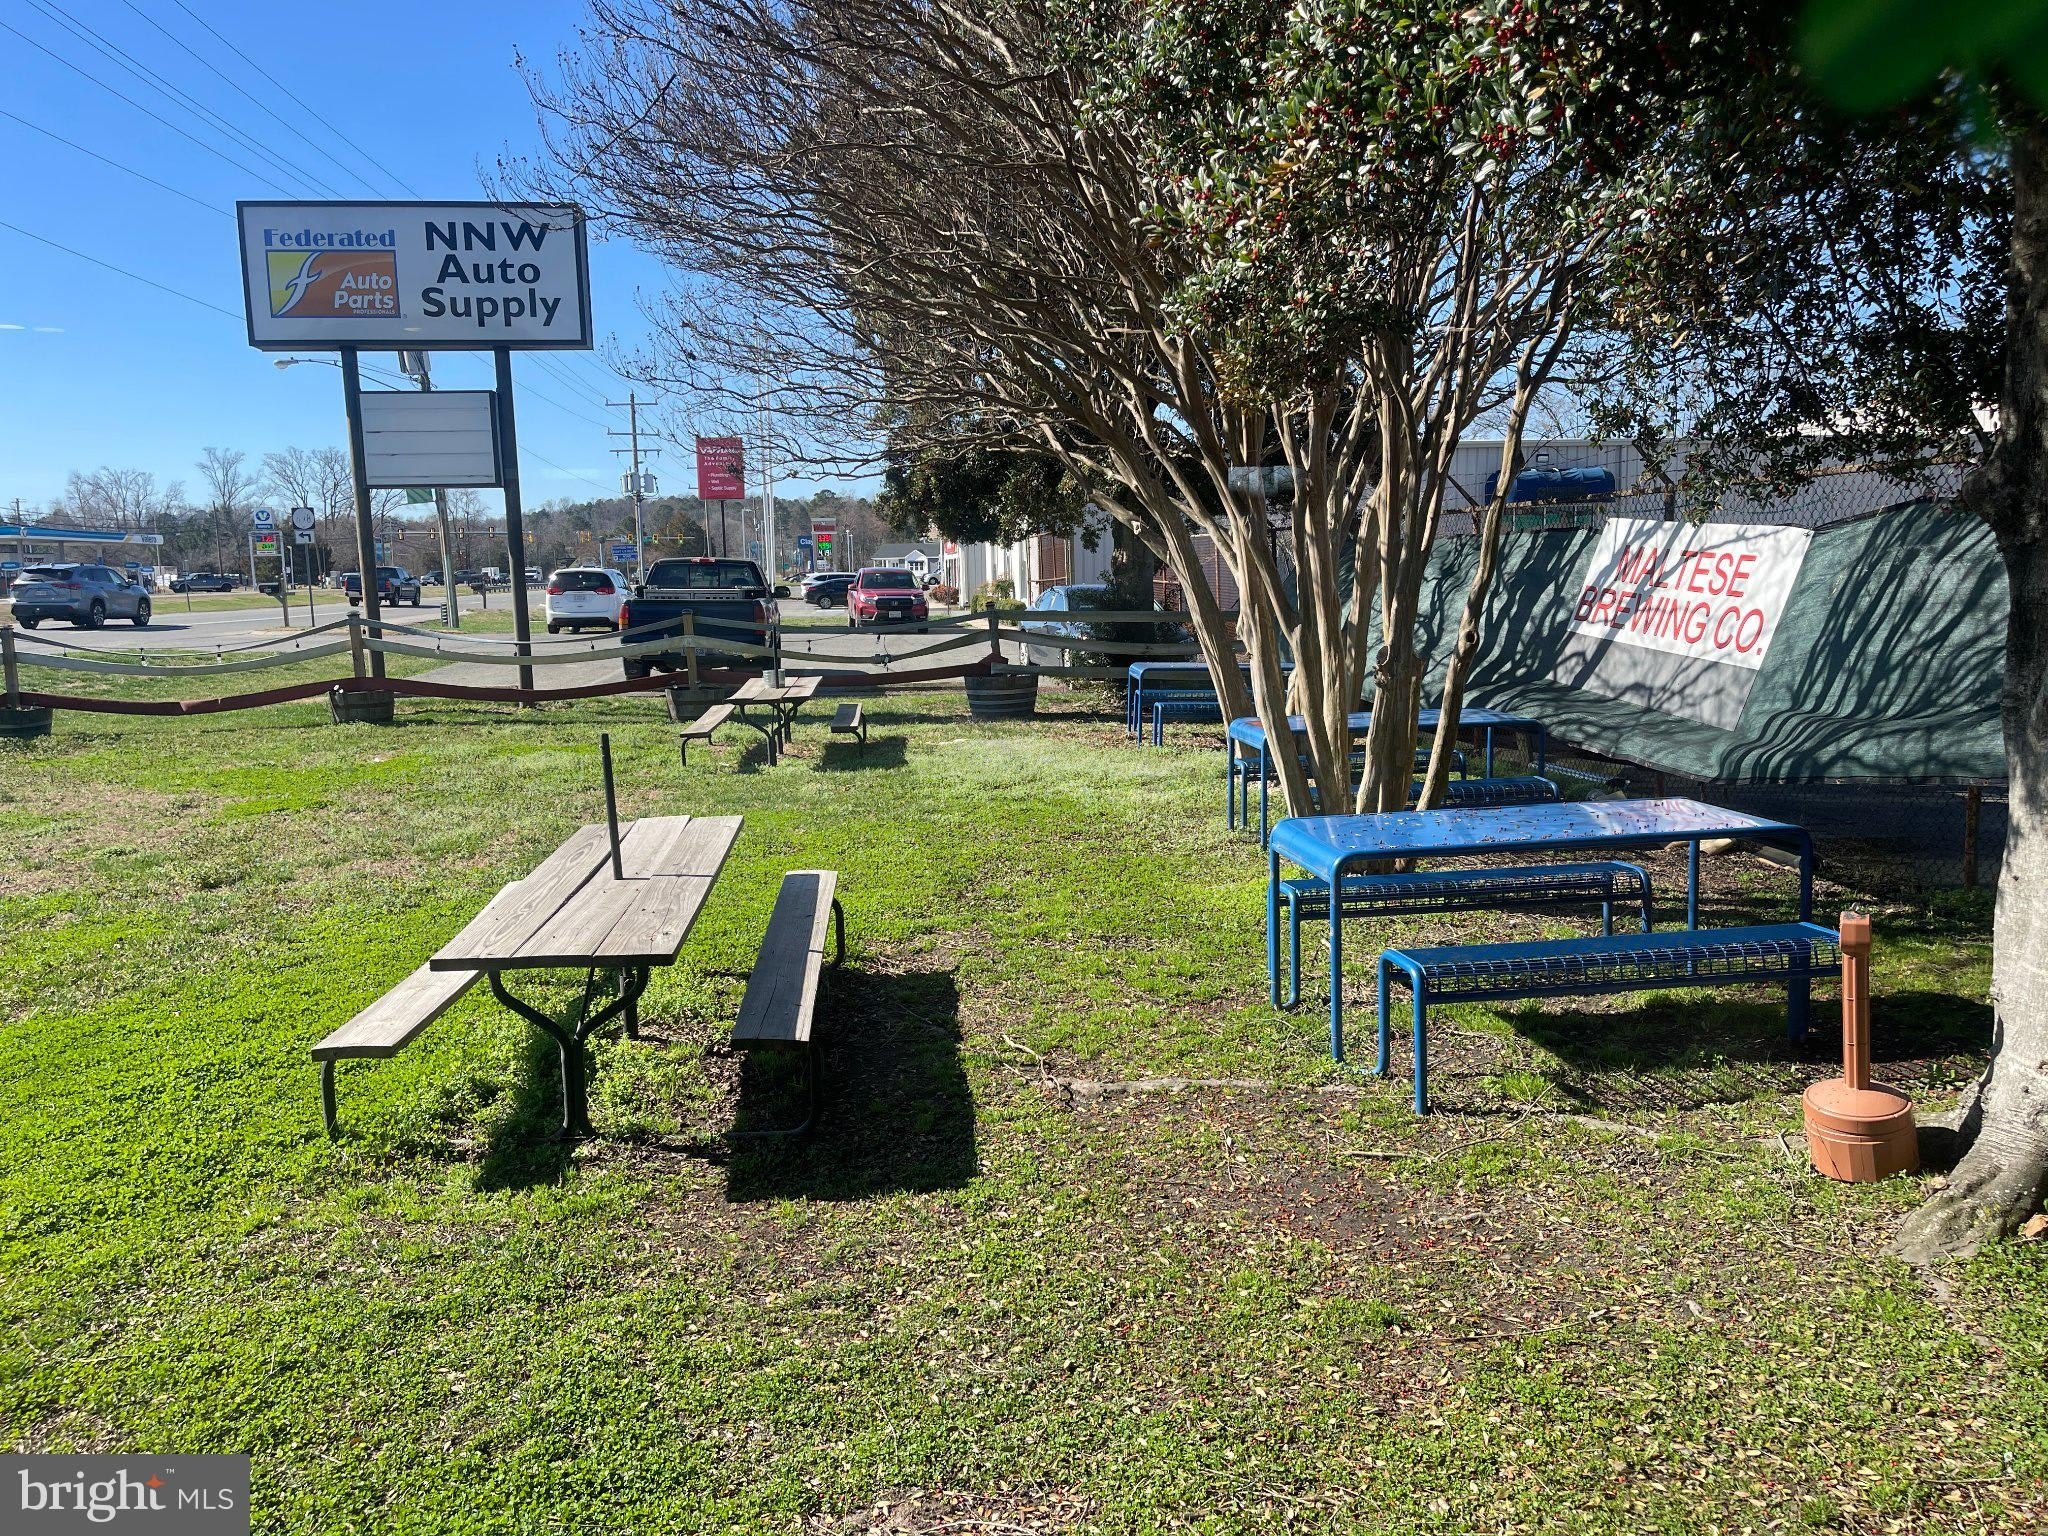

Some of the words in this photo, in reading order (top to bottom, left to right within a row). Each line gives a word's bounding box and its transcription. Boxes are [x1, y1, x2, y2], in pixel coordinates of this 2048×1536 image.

[264, 228, 396, 247] Federated
[425, 221, 550, 251] NNW
[340, 271, 393, 290] Auto
[437, 254, 541, 284] Auto
[334, 290, 394, 309] Parts
[421, 287, 562, 327] Supply
[1614, 545, 1757, 597] MALTESE
[1574, 585, 1711, 644] BREWING
[1713, 605, 1764, 656] CO.
